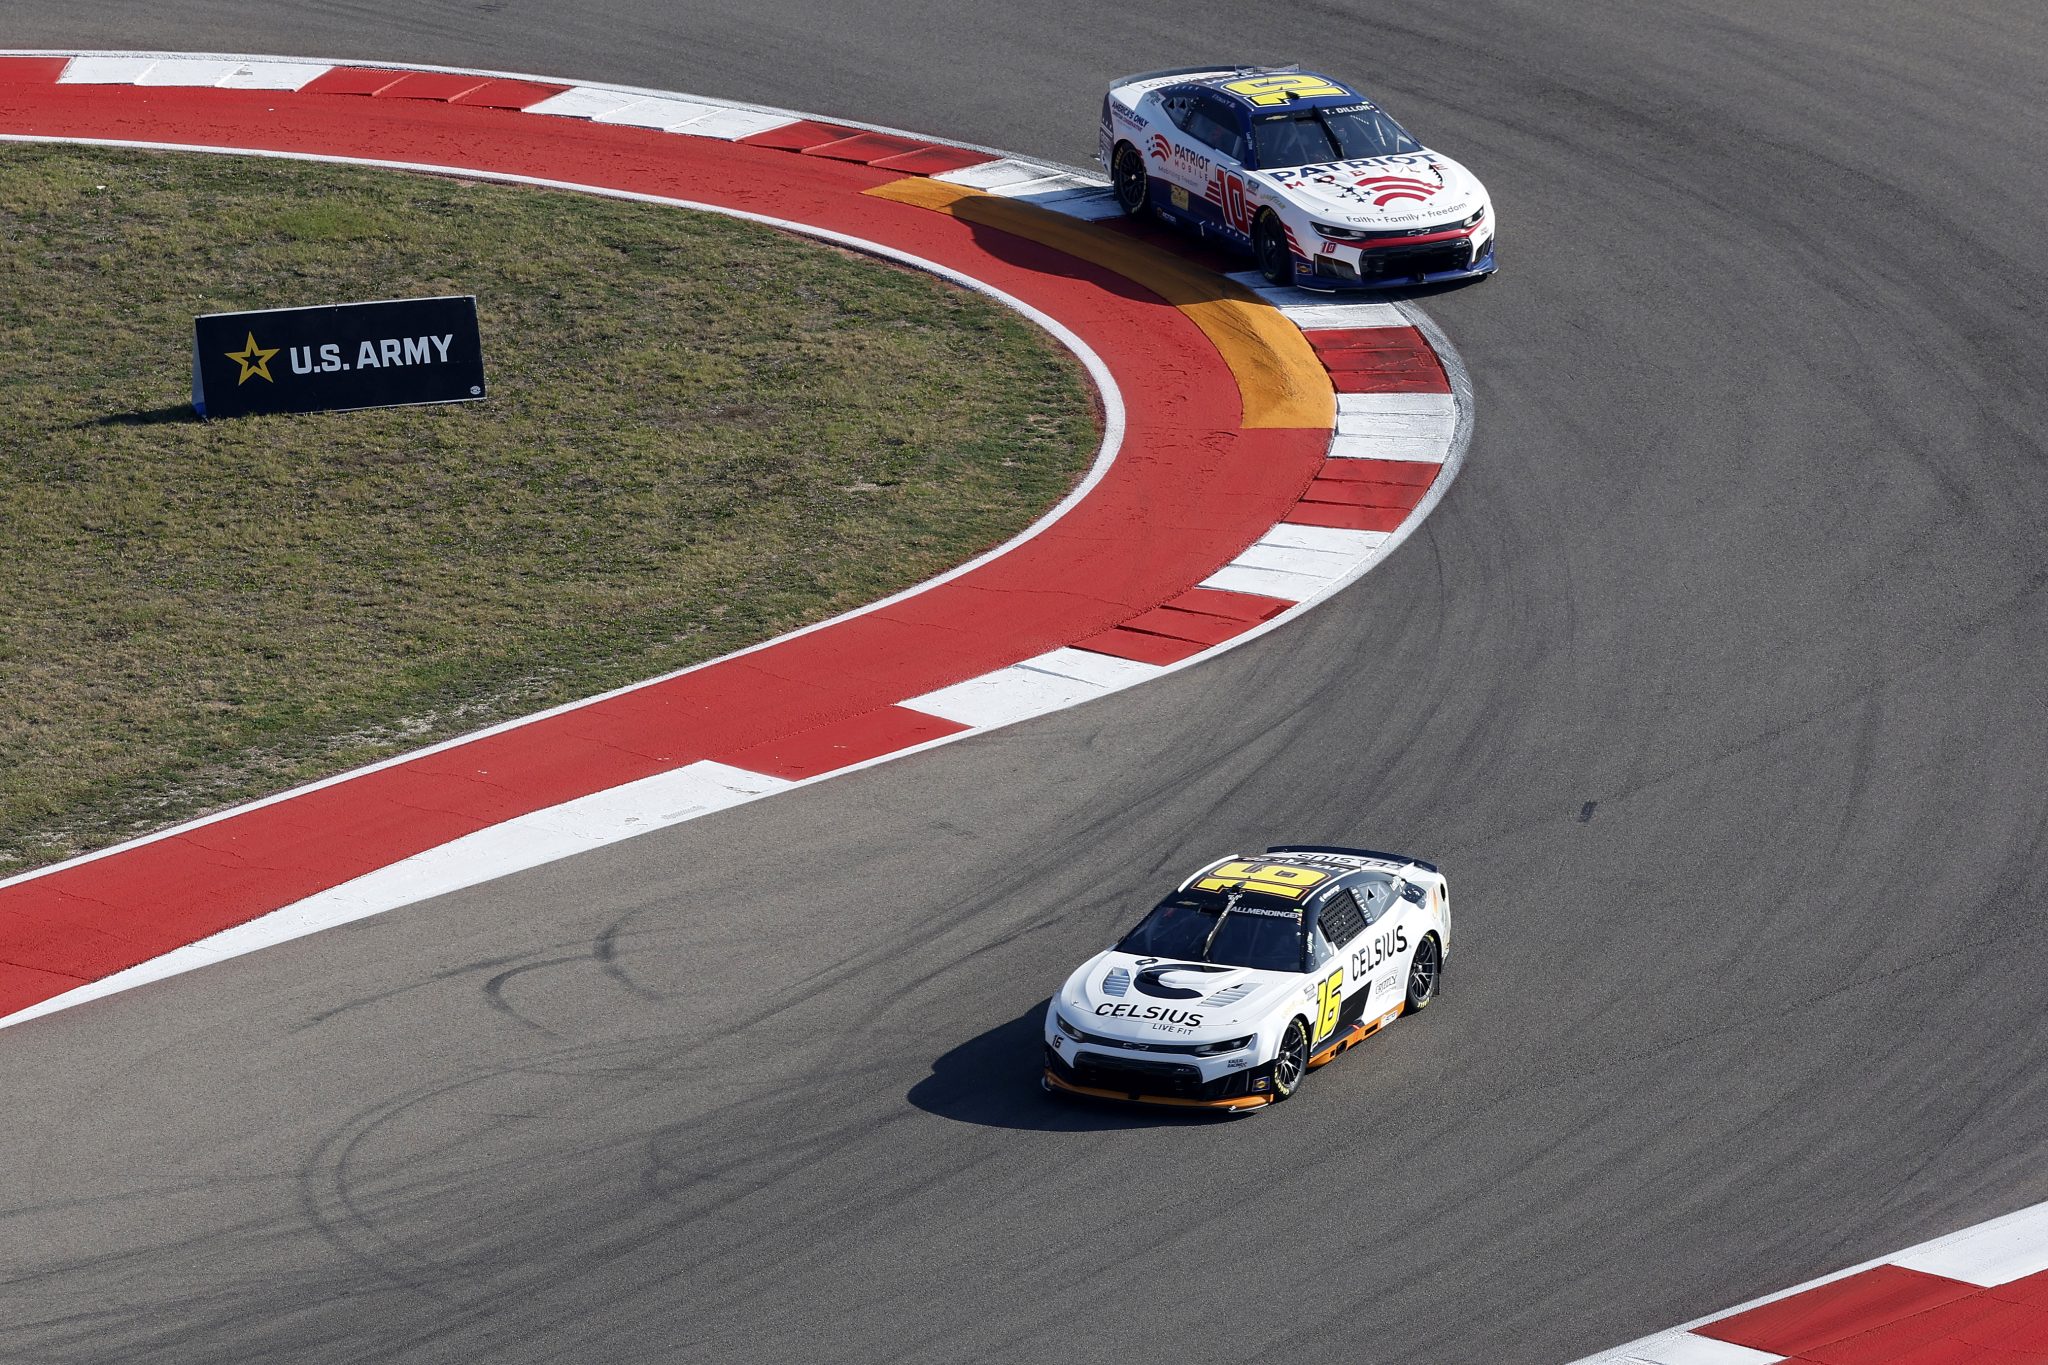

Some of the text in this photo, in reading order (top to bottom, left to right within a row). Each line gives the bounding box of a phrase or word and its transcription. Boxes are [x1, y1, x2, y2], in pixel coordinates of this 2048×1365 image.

[1133, 114, 1150, 128] ONLY
[1335, 104, 1370, 114] DILLON
[1174, 144, 1211, 173] PATRIOT
[1174, 160, 1209, 182] MOBILE
[1268, 153, 1440, 183] PATRIOT
[1284, 163, 1448, 190] MOBILE
[1215, 164, 1250, 238] 10
[1346, 202, 1468, 224] Faith Family Freedom
[1322, 241, 1338, 254] 10
[290, 333, 454, 375] U.S. ARMY
[1191, 861, 1331, 901] 16
[1352, 925, 1408, 982] CELSIUS
[1095, 1003, 1204, 1028] CELSIUS
[1311, 966, 1344, 1048] 16
[1051, 1034, 1064, 1049] 16
[1152, 1023, 1194, 1036] LIVE FIT
